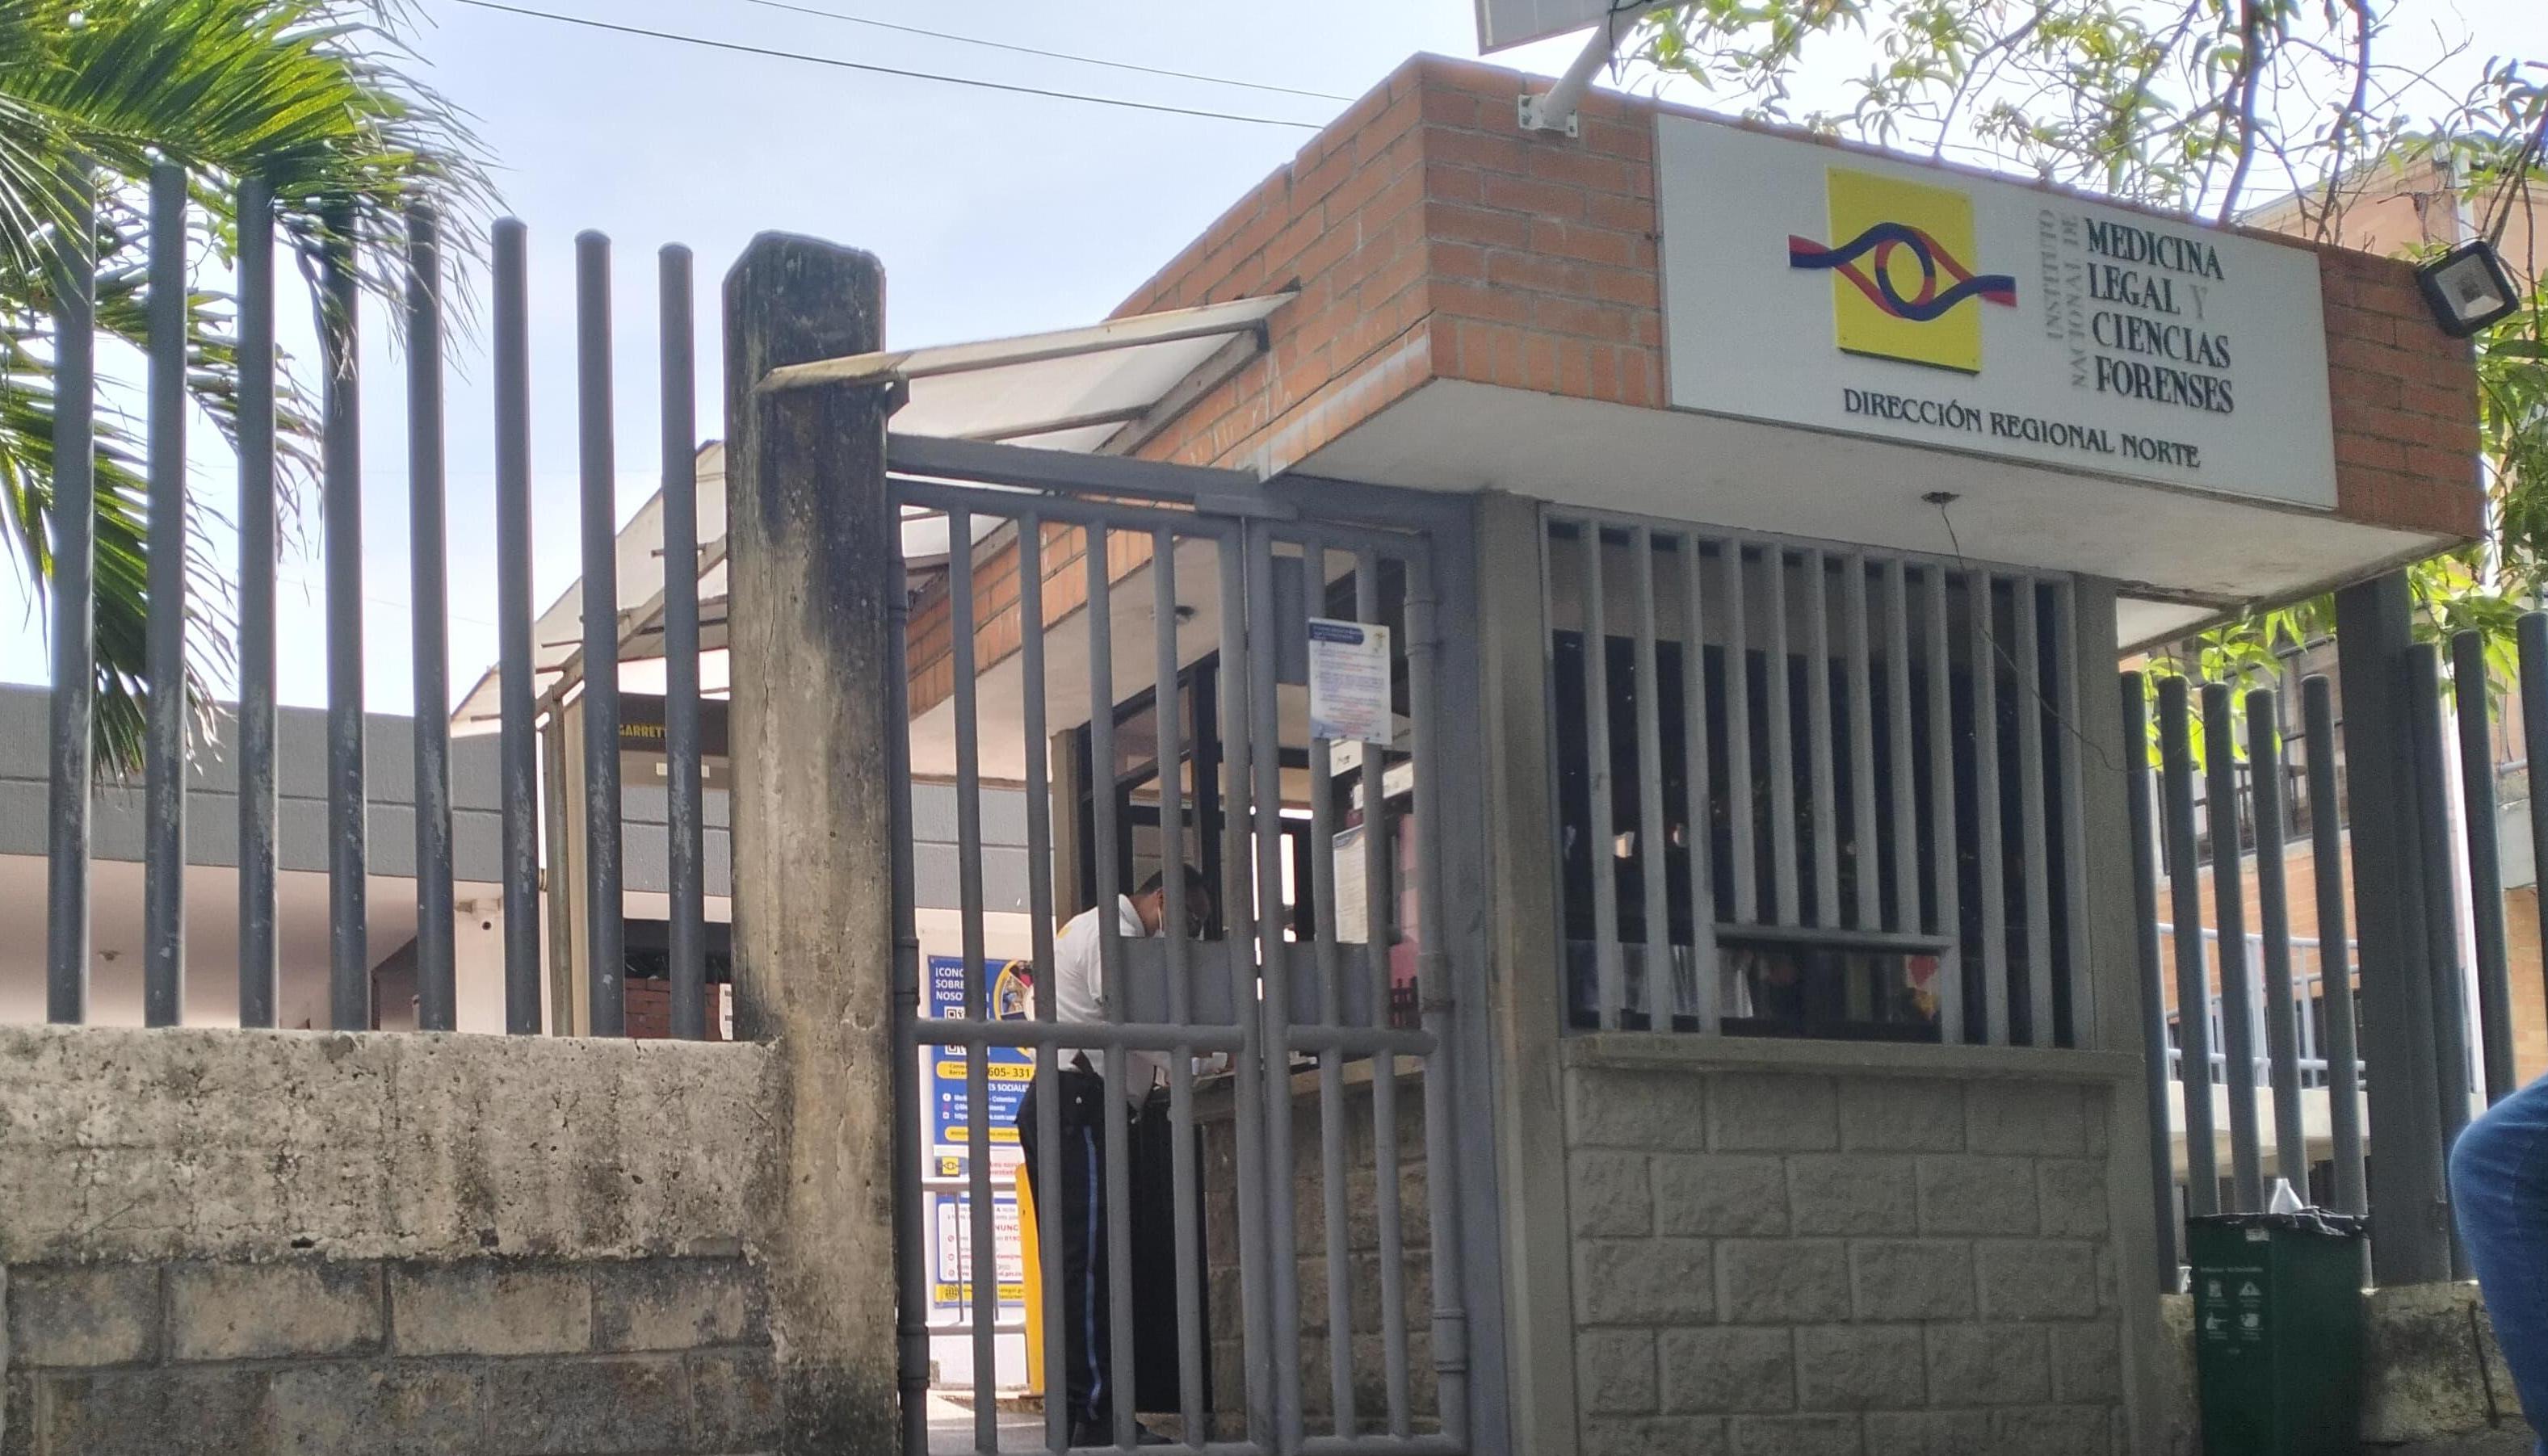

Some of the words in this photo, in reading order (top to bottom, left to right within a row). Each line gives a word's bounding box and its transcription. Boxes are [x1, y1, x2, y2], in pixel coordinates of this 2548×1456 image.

[2084, 217, 2225, 281] MEDICINA
[2087, 262, 2181, 315] LEGAL
[2187, 284, 2209, 321] Y
[2092, 311, 2231, 369] CIENCIAS
[2094, 355, 2235, 414] FORENSES
[1843, 388, 1983, 433] DIRECCIÓN
[1989, 412, 2115, 454] REGIONAL
[2121, 433, 2202, 468] NORTE
